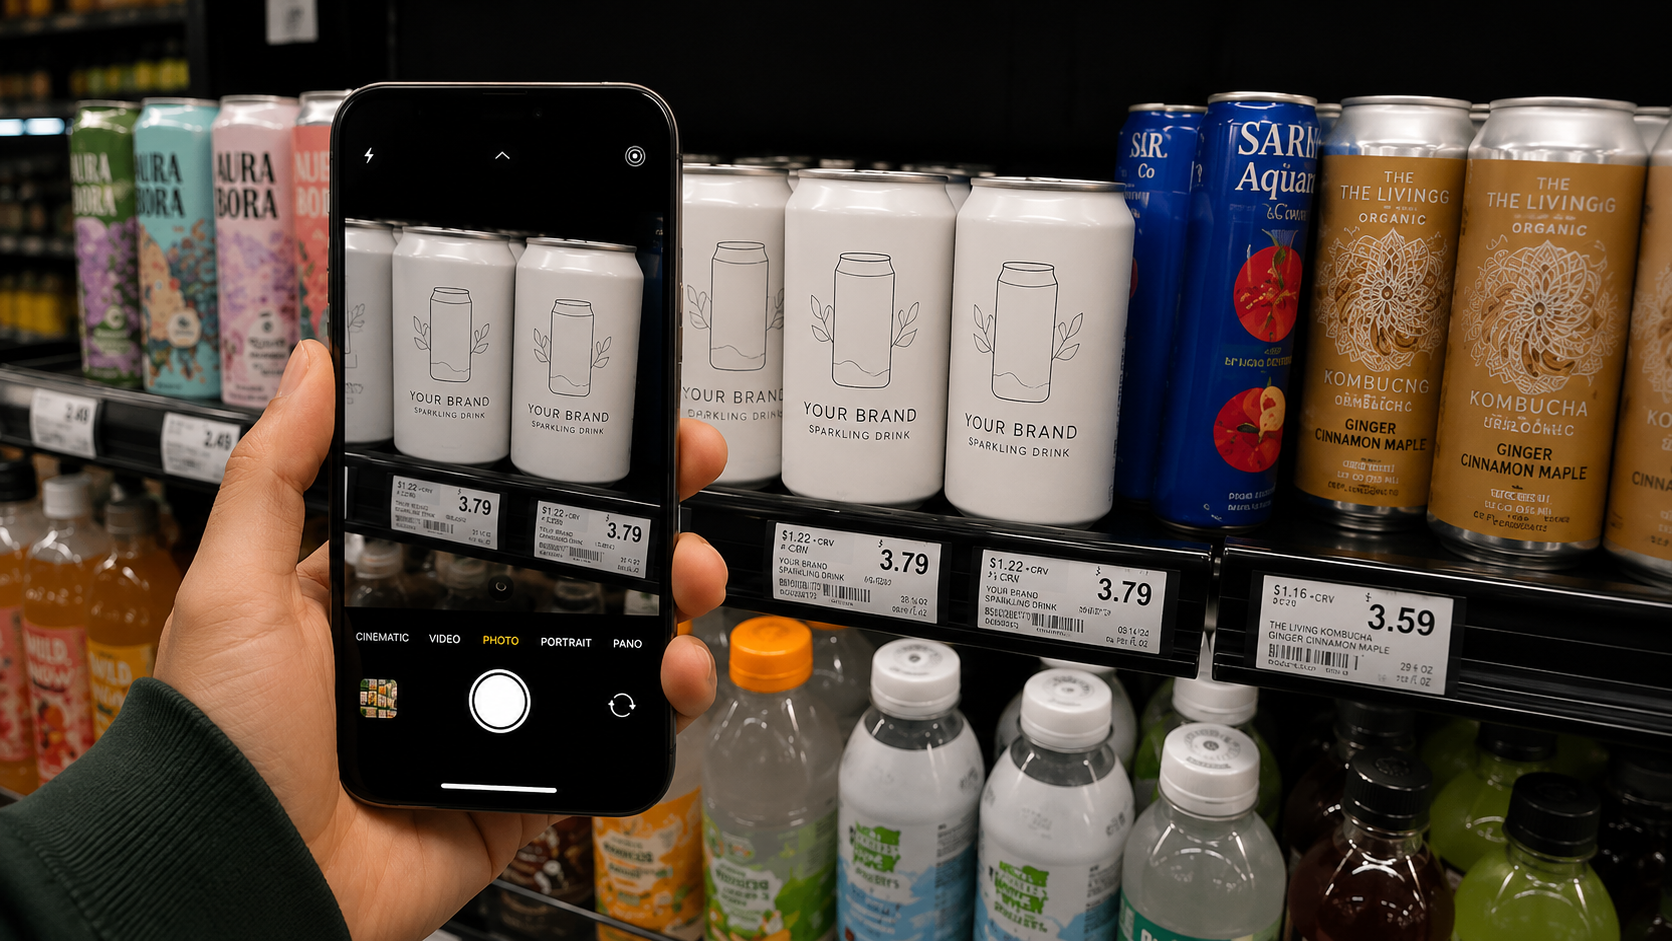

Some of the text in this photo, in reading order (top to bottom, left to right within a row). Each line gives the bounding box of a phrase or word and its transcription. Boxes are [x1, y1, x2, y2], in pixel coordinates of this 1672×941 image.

[1138, 163, 1155, 179] Co
[1384, 170, 1414, 183] THE
[1537, 177, 1570, 191] THE
[1341, 184, 1450, 204] THE LIVINGG
[1487, 192, 1521, 209] THE
[1359, 212, 1426, 225] ORGANIC
[1512, 222, 1587, 236] ORGANIC
[410, 391, 490, 407] YOUR BRAND
[683, 386, 725, 403] YOUR
[804, 401, 917, 422] YOUR BRAND
[1470, 390, 1588, 417] KOMBUCHA
[414, 407, 457, 419] SPARKLING
[527, 403, 609, 423] YOUR BRAND
[531, 420, 604, 435] SPARKLING DRINK
[809, 424, 910, 441] SPARKLING DRINK
[965, 412, 1077, 439] YOUR BRAND
[1345, 418, 1396, 435] GINGER
[968, 436, 1070, 457] SPARKLING DRINK
[1315, 428, 1427, 451] CINNAMON MAPLE
[1497, 443, 1552, 461] GINGER
[1461, 453, 1588, 480] CINNAMON MAPLE
[458, 496, 492, 515] 3.79
[607, 522, 642, 543] 3.79
[781, 529, 811, 544] $1.22
[879, 548, 929, 575] 3.79
[989, 557, 1023, 573] $1.22
[1097, 577, 1152, 606] 3.79
[1274, 584, 1307, 599] $1.16
[1368, 603, 1435, 636] 3.59
[355, 632, 410, 643] CINEMATIC
[429, 634, 461, 645] VIDEO
[1269, 620, 1286, 630] THE
[1320, 628, 1373, 642] KOMBUCHA
[482, 635, 519, 646] PHOTO
[540, 637, 592, 648] PORTRAIT
[613, 639, 643, 649] PANO
[1269, 631, 1390, 655] GINGER CINNAMON MAPLE
